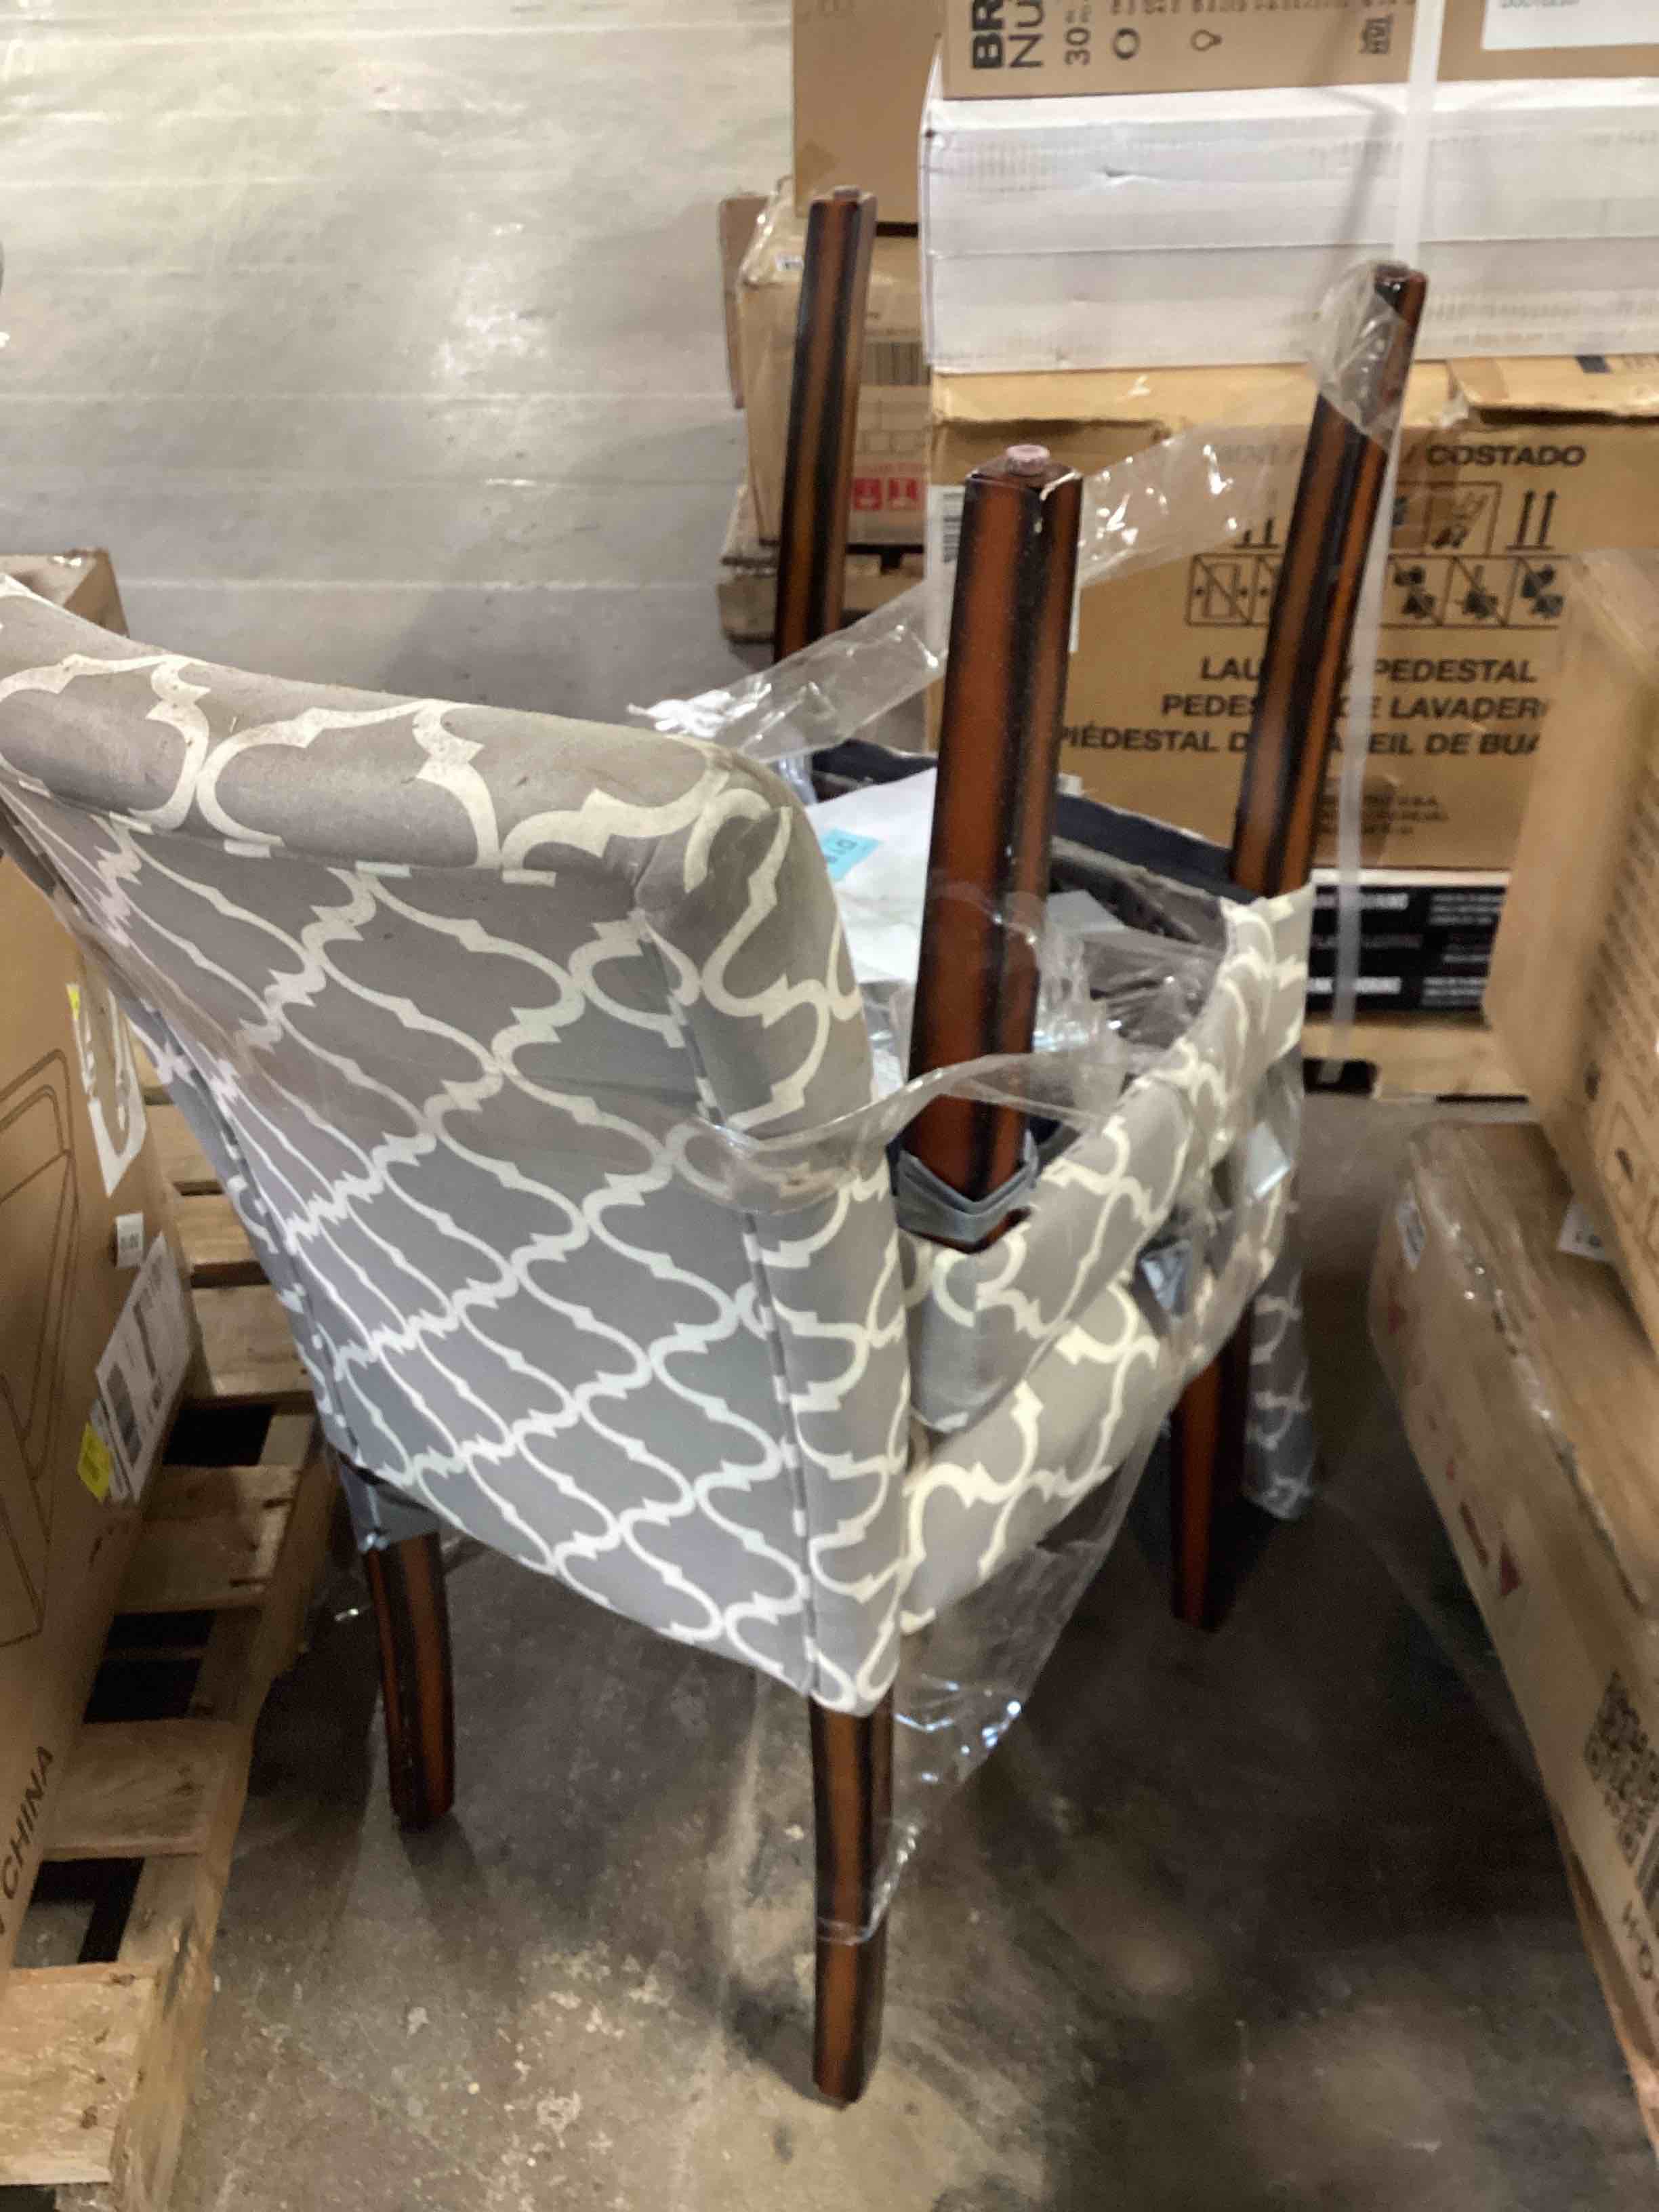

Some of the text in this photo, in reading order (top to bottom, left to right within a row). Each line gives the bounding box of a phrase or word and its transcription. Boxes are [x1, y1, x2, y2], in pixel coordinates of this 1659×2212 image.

[1426, 444, 1586, 468] COSTADO
[1374, 657, 1537, 683] PEDESTAL
[1425, 732, 1472, 754] DE
[3, 1745, 53, 1900] CHINA
